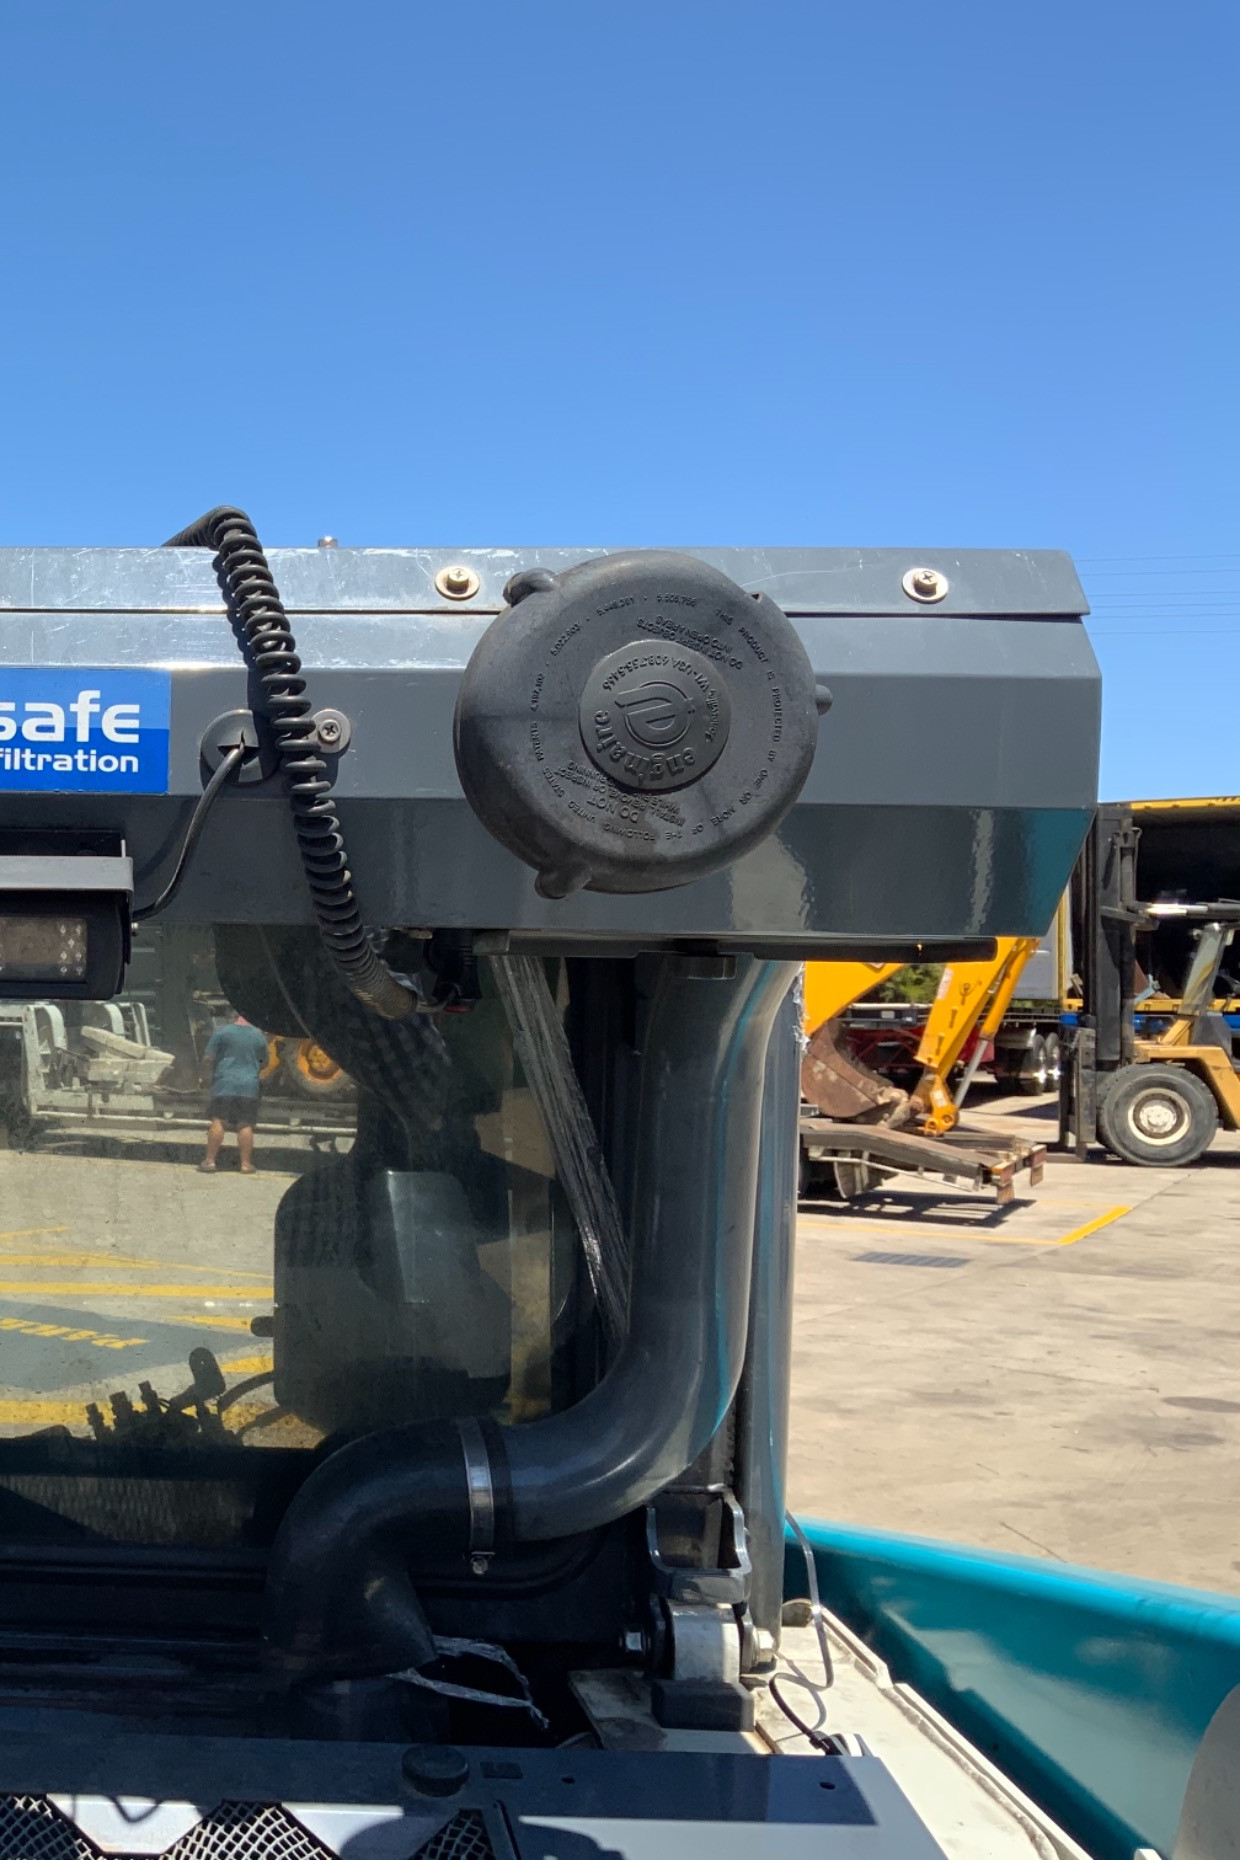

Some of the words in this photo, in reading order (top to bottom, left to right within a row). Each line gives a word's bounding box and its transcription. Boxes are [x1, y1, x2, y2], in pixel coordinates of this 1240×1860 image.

[714, 607, 734, 625] THIS
[737, 626, 769, 664] PRODUCT
[707, 649, 727, 664] NOT
[728, 656, 743, 670] DO
[771, 686, 782, 743] PROTECTED
[767, 749, 778, 763] BY
[542, 765, 566, 798] STATES
[753, 768, 769, 790] ONE
[592, 782, 608, 795] OR
[586, 796, 620, 815] NOT
[738, 790, 753, 806] OR
[567, 799, 596, 824] UNITED
[620, 805, 640, 823] DO
[710, 806, 737, 827] MORE
[604, 821, 656, 841] FOLLOWING
[692, 822, 705, 836] OF
